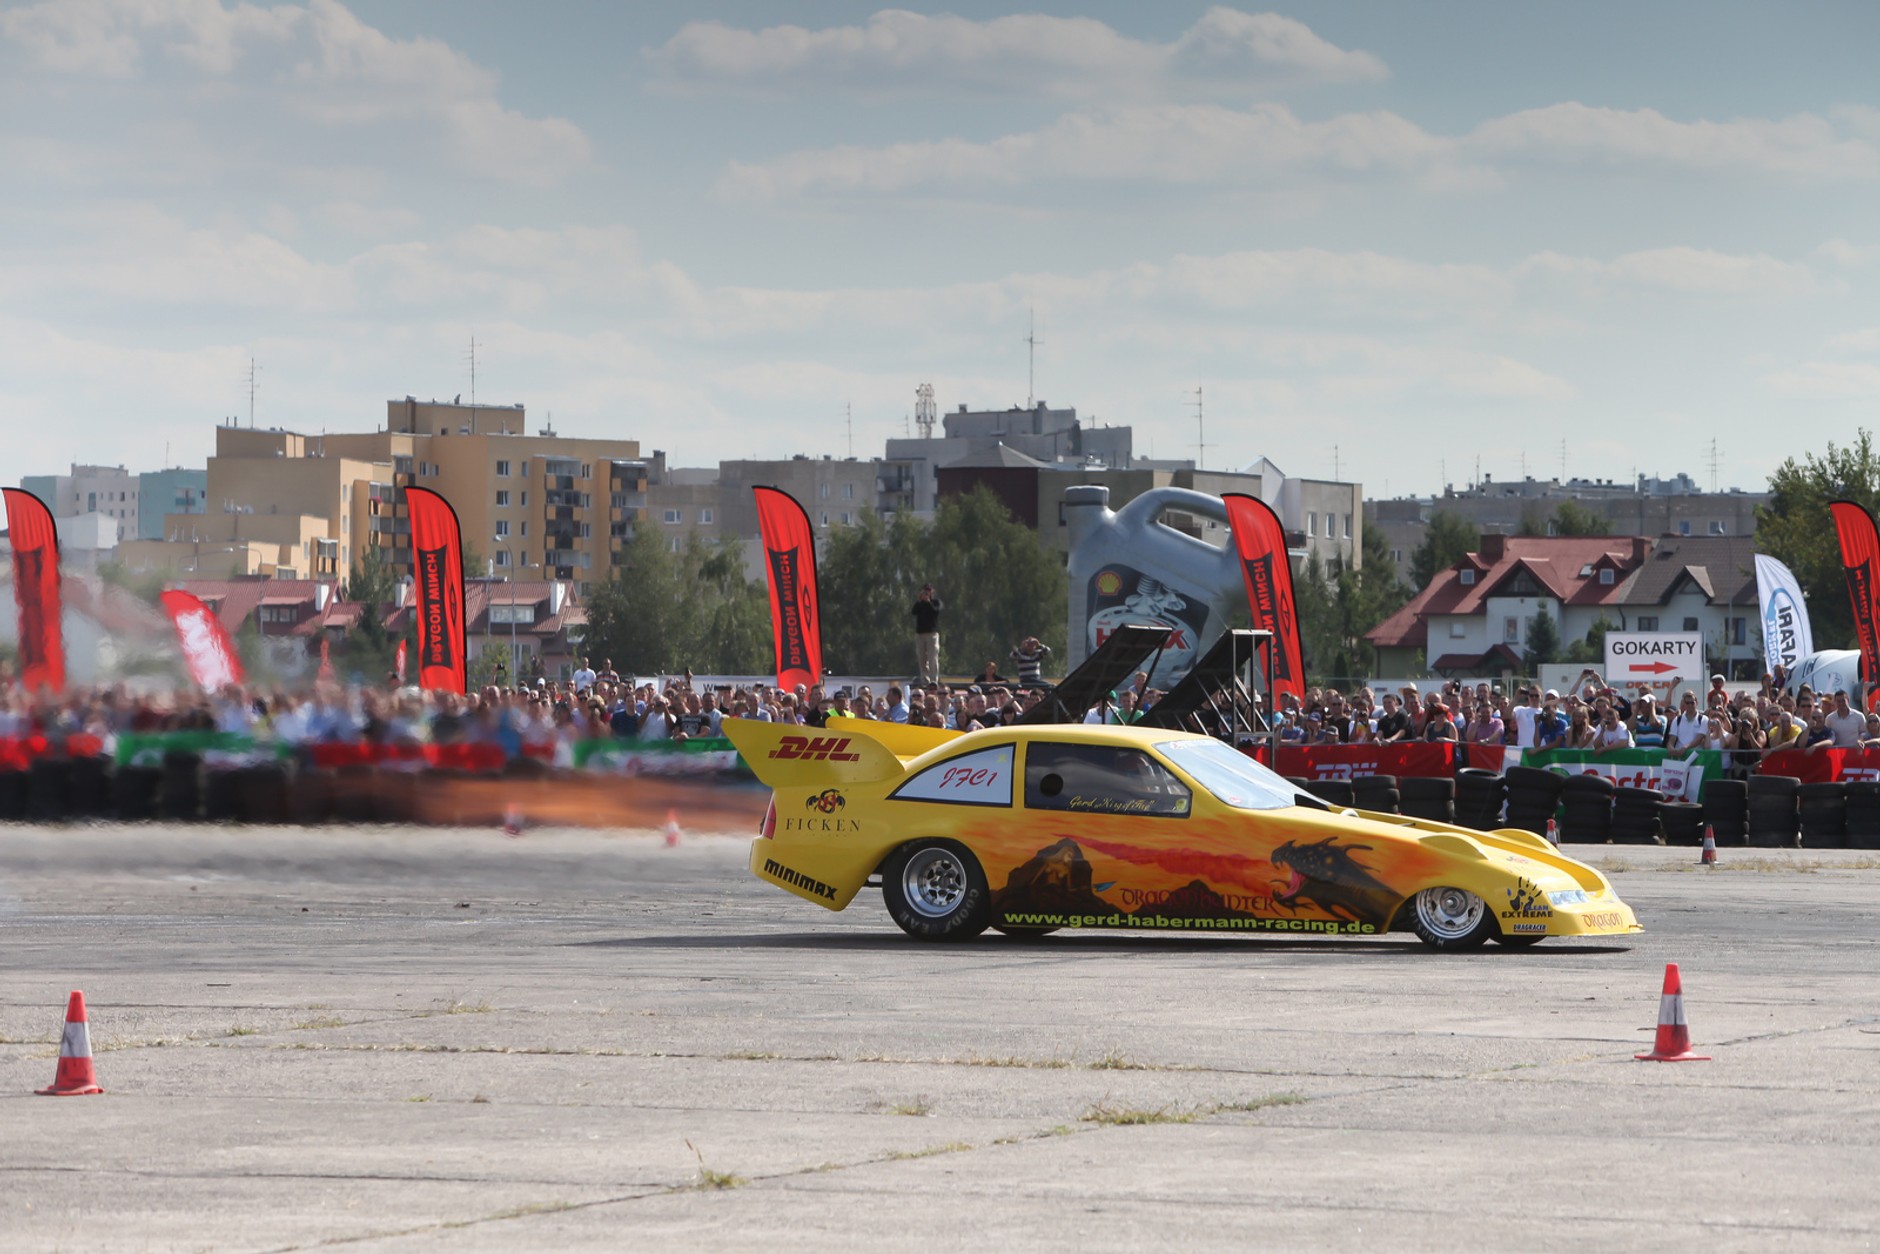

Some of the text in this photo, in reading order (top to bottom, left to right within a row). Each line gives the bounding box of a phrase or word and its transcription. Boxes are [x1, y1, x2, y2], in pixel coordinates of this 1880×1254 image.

[1612, 641, 1697, 655] GOKARTY
[773, 736, 854, 762] DHL
[785, 818, 860, 832] FICKEN
[763, 858, 838, 901] MINIMAX
[1501, 910, 1554, 918] EXTREME
[1004, 912, 1376, 935] www.gerd-habermann-racing.de
